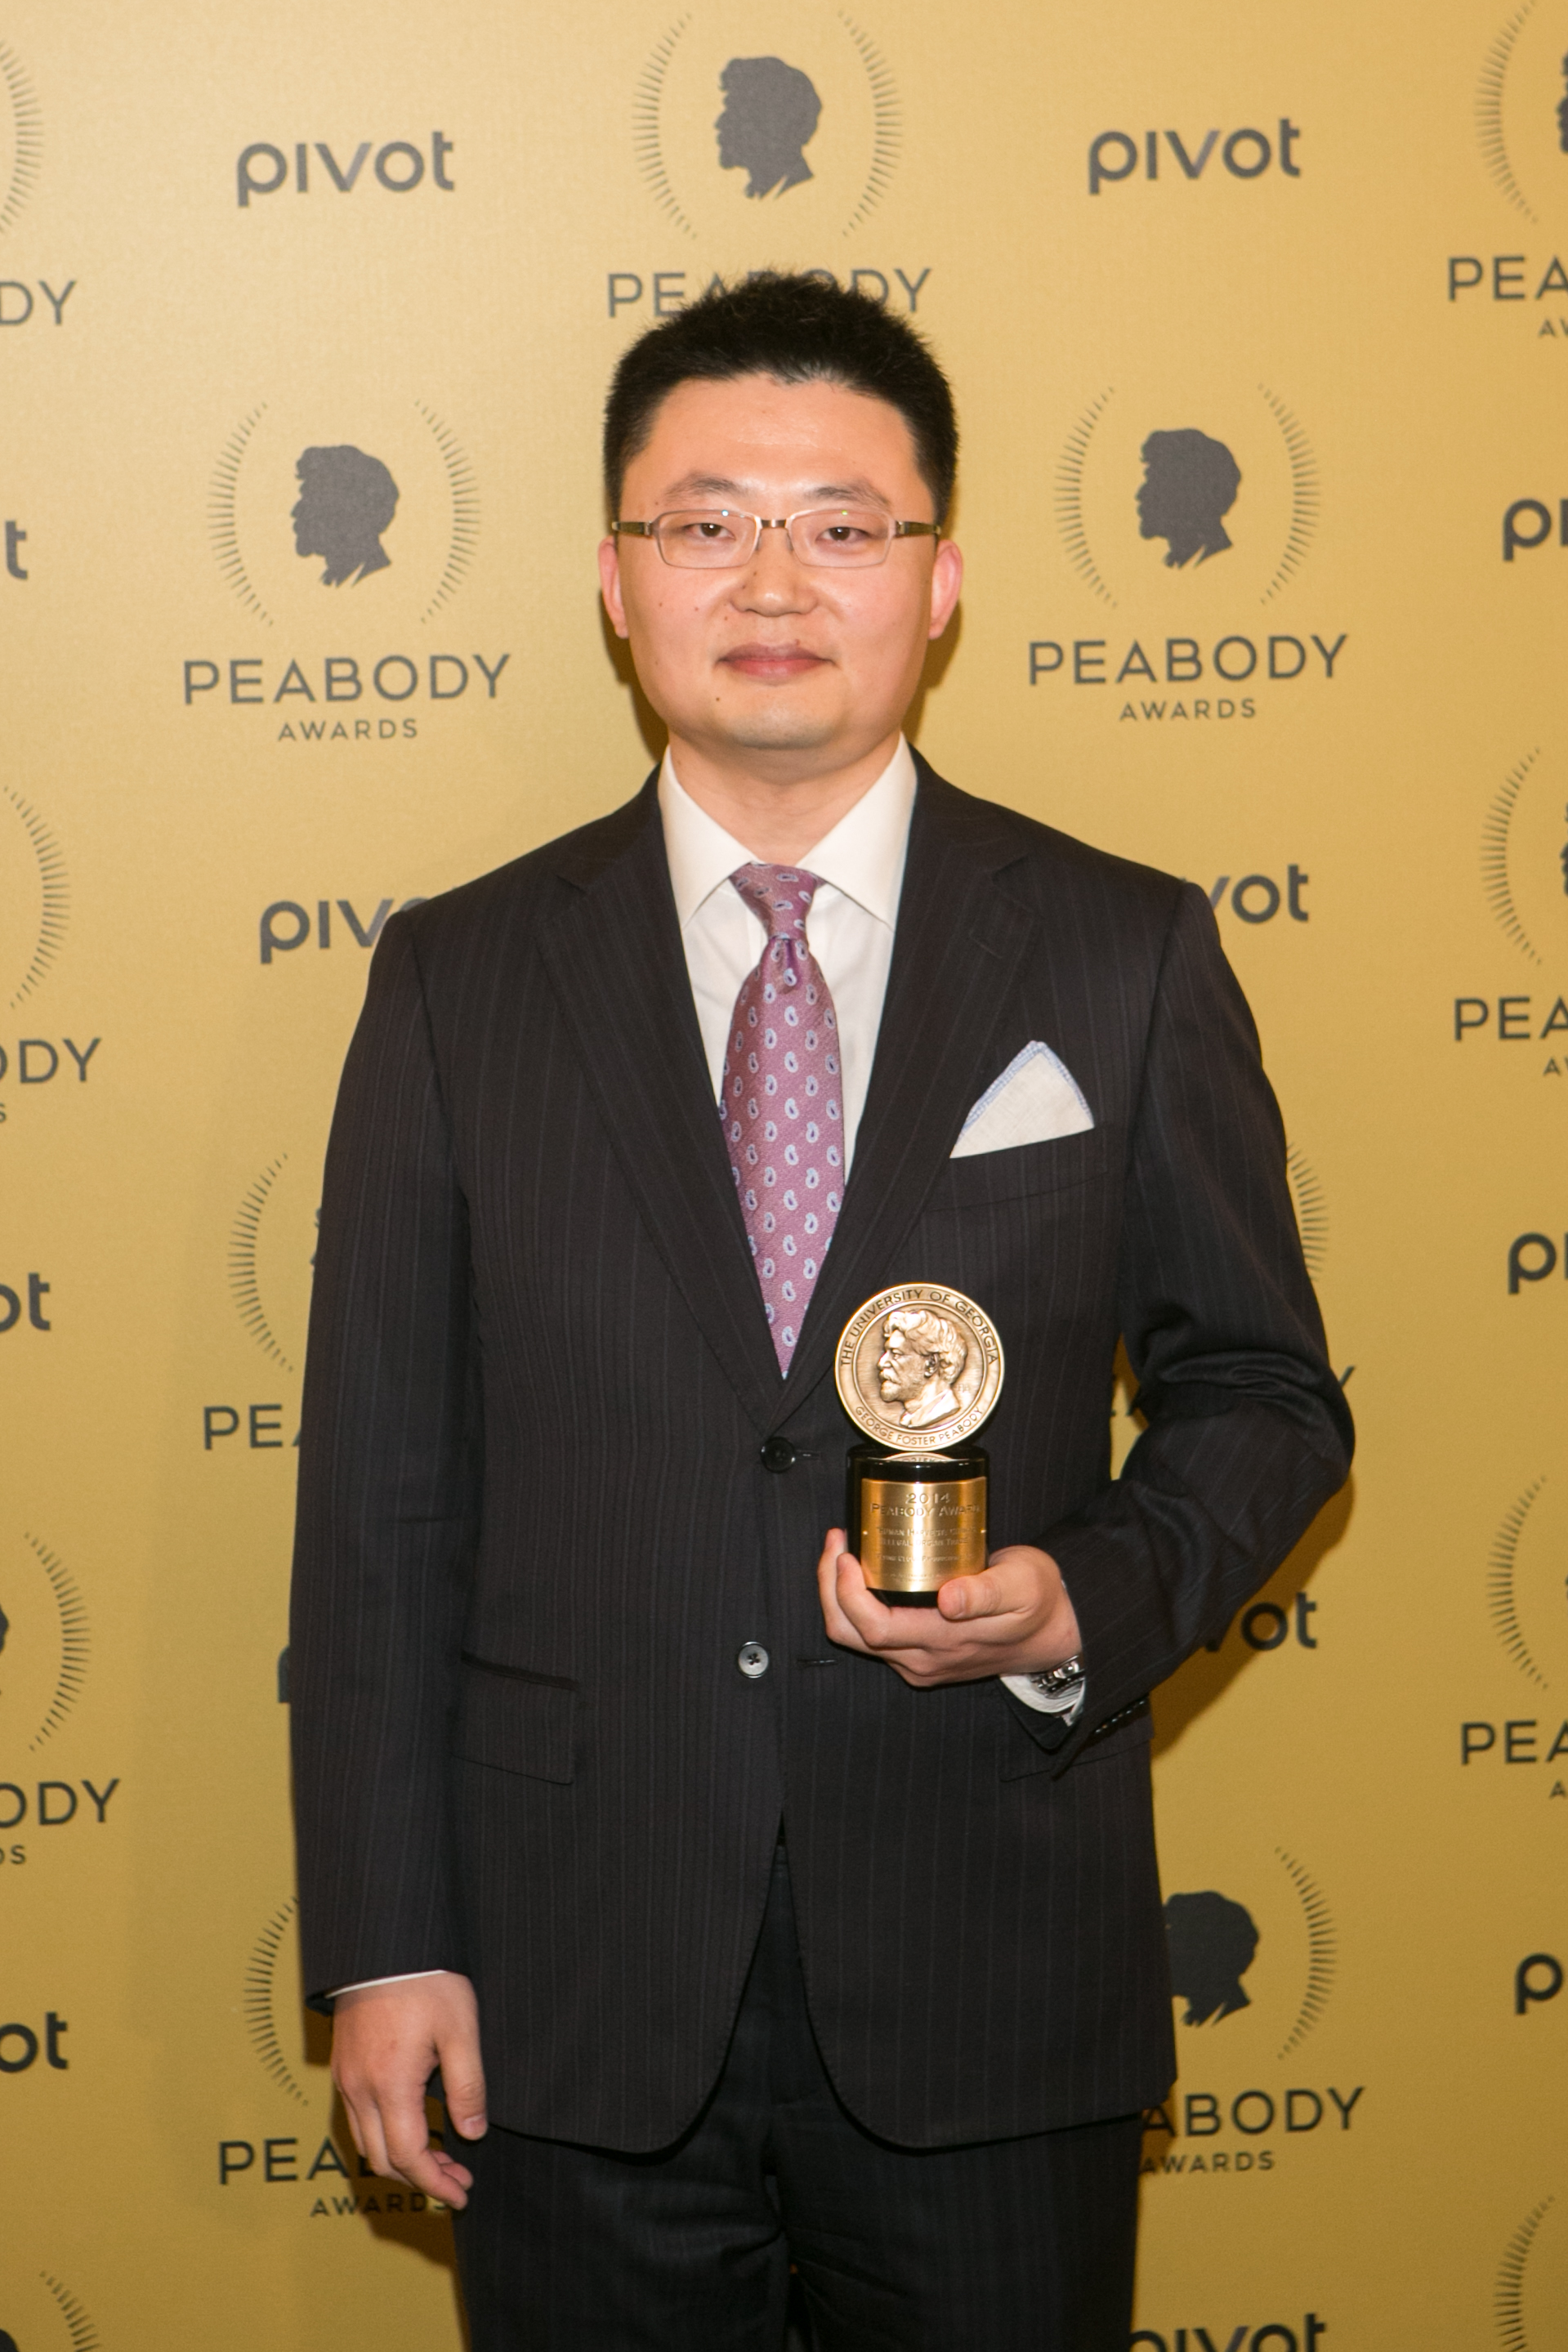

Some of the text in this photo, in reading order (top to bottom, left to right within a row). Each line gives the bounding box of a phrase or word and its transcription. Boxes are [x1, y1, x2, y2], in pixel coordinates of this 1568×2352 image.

[236, 131, 455, 208] pivot
[1088, 118, 1302, 196] pivot
[183, 653, 511, 705] PEABODY
[1028, 633, 1347, 686] PEABODY
[277, 718, 418, 741] AWARDS
[1119, 698, 1257, 722] AWARDS
[840, 1289, 998, 1366] THE UNIVERSITY OF GEORGIA
[855, 1406, 984, 1446] GEORGE FOSTER PEABODY
[869, 1503, 936, 1518] PEABODY
[905, 1492, 950, 1505] 2014
